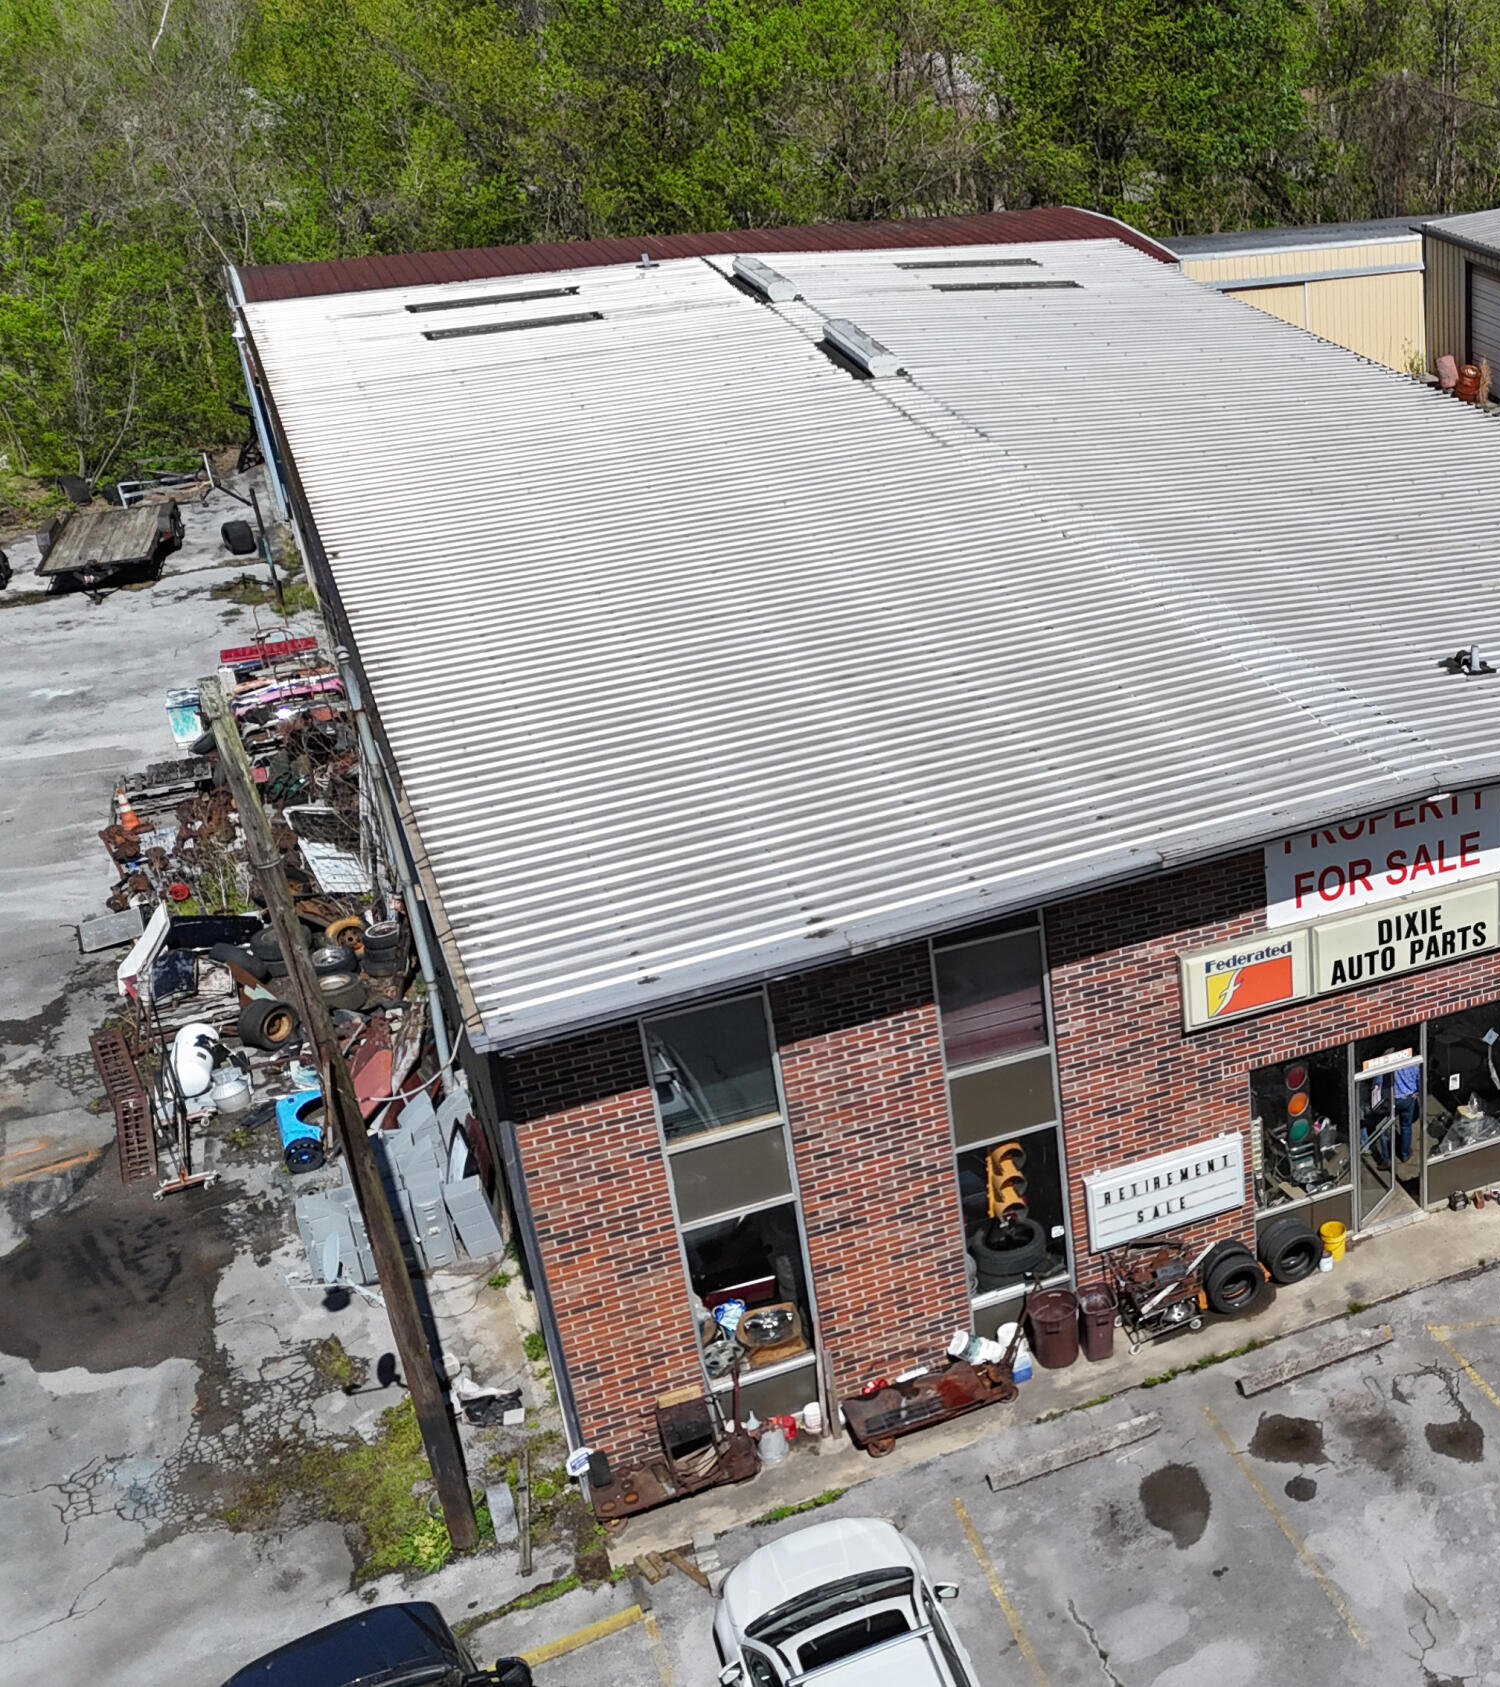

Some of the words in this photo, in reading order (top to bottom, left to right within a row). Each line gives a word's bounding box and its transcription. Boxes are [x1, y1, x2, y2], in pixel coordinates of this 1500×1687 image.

[1294, 858, 1374, 909] FOR
[1386, 831, 1481, 885] SALE
[1377, 905, 1443, 946] DIXIE
[1204, 941, 1293, 974] Federated
[1331, 946, 1396, 986] AUTO
[1409, 922, 1487, 965] PARTS
[1103, 1154, 1229, 1207] RETIREMENT
[1136, 1196, 1186, 1223] SALE
